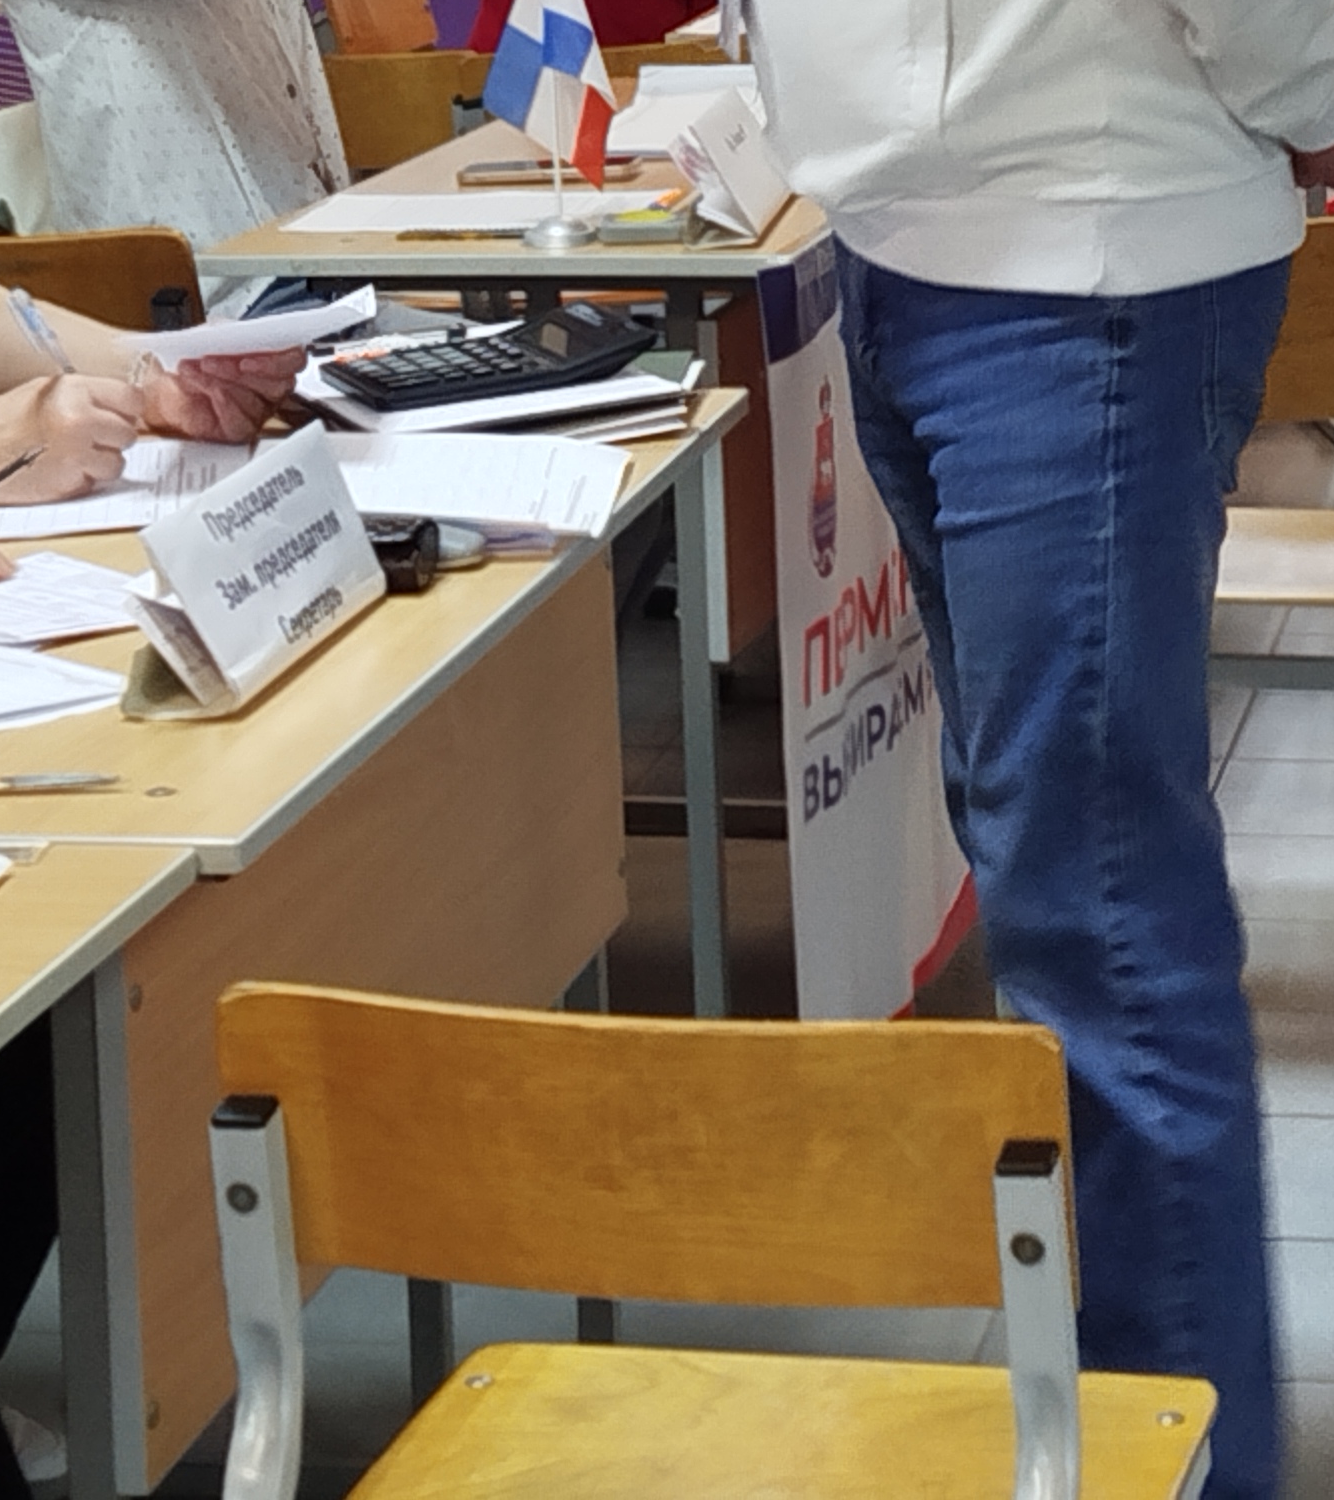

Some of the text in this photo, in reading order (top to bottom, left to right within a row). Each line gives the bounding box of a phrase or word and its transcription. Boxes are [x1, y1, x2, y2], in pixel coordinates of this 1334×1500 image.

[202, 465, 305, 542] Председатель
[215, 509, 342, 610] Зам. председателя
[278, 585, 343, 643] Секретарь
